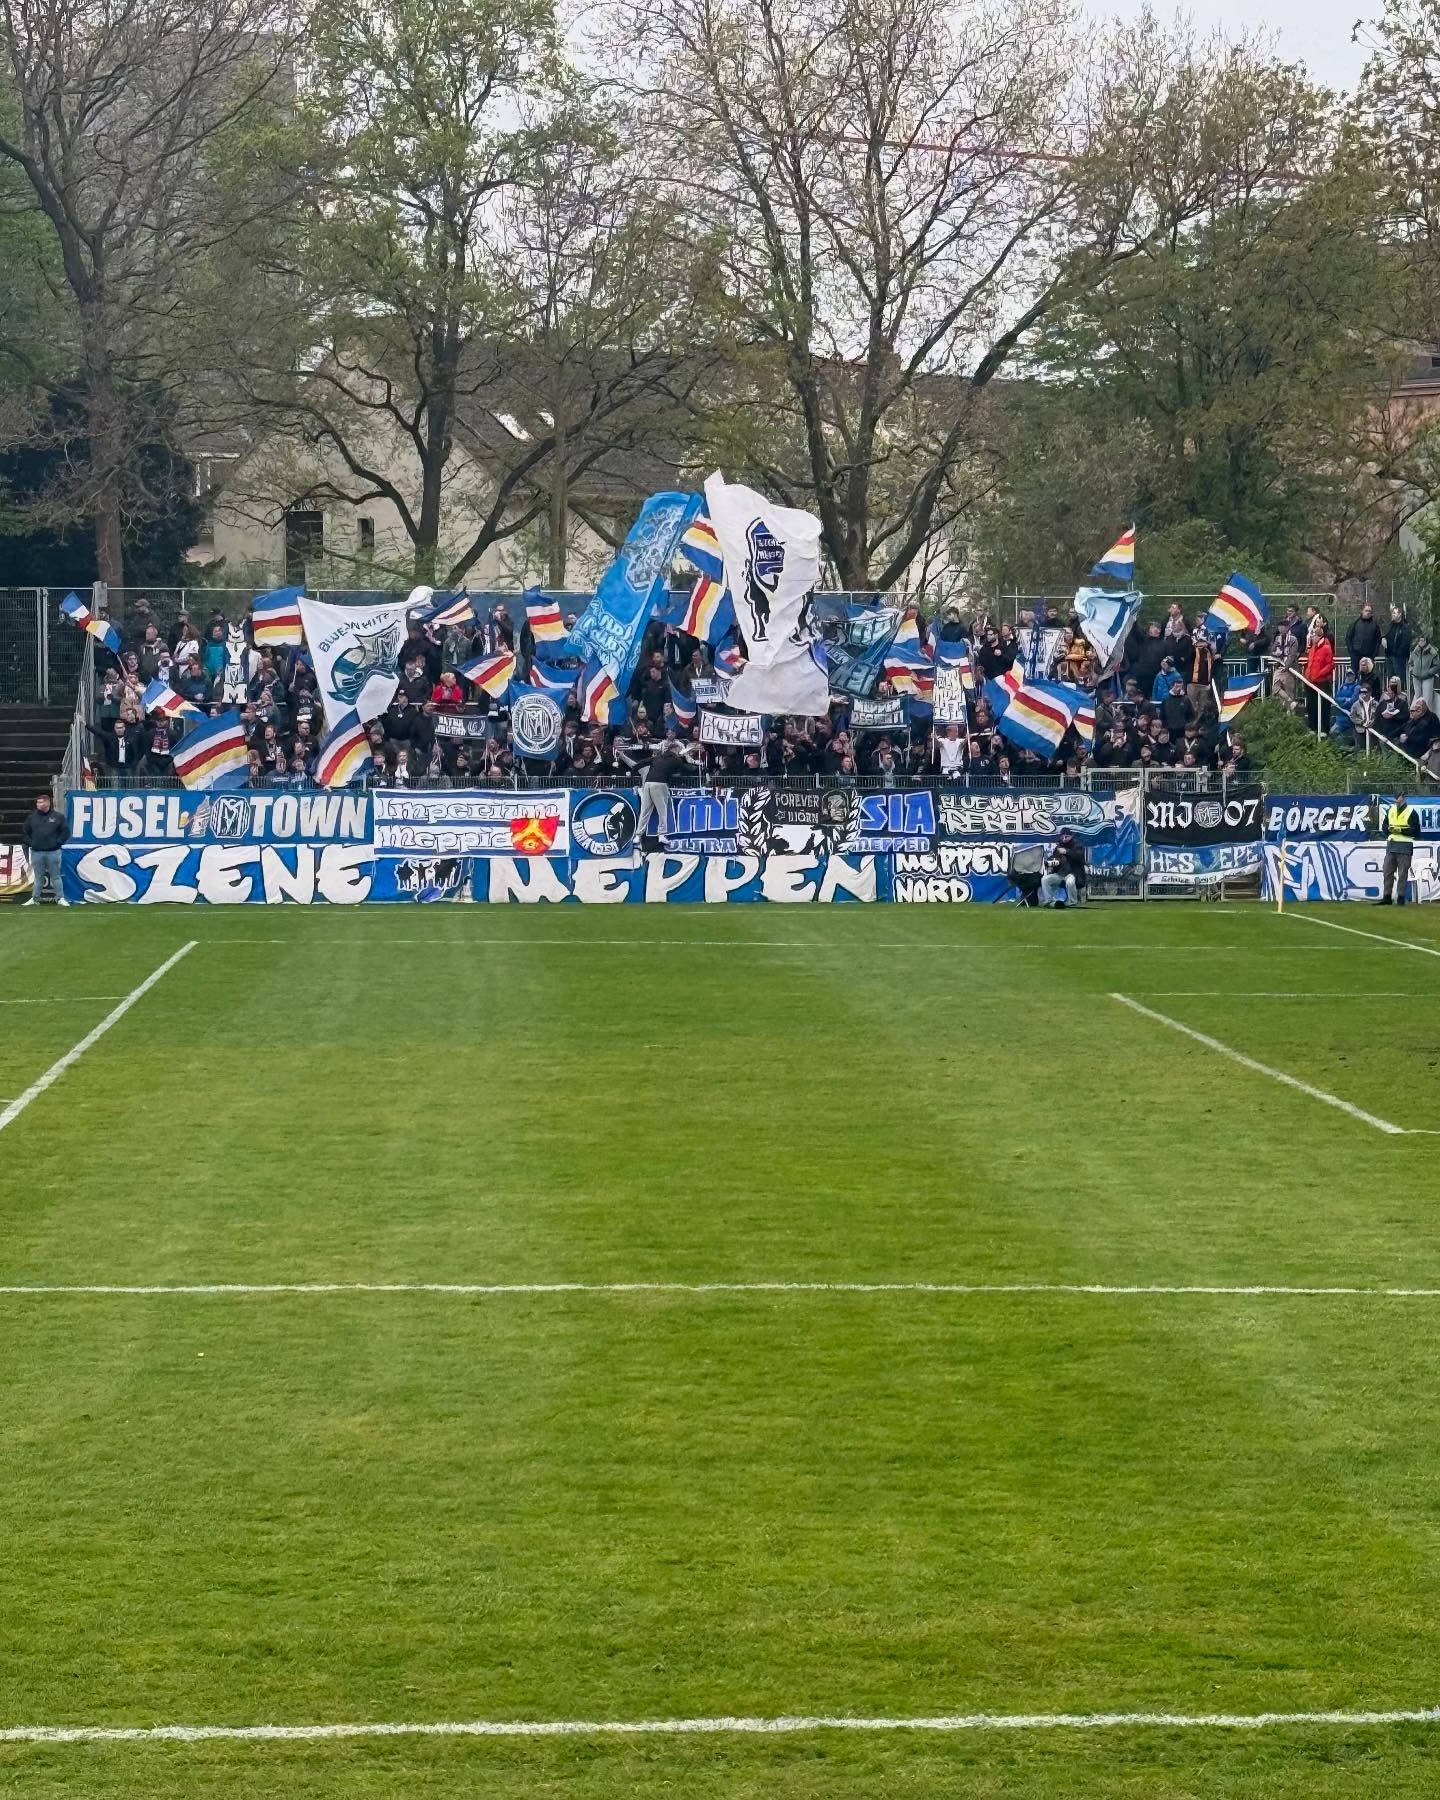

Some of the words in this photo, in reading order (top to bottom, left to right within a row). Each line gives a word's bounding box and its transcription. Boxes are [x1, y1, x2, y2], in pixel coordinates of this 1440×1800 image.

[774, 793, 819, 809] FOREVER
[1223, 799, 1259, 827] 07
[72, 796, 186, 838] FUSEL
[250, 796, 368, 839] TOWN
[1268, 801, 1369, 833] BÖRGER
[76, 844, 375, 904] SZENE
[488, 854, 878, 904] MEPPEN
[893, 845, 1011, 876] MEPPEN
[1150, 851, 1195, 873] HES
[893, 875, 973, 904] NORD
